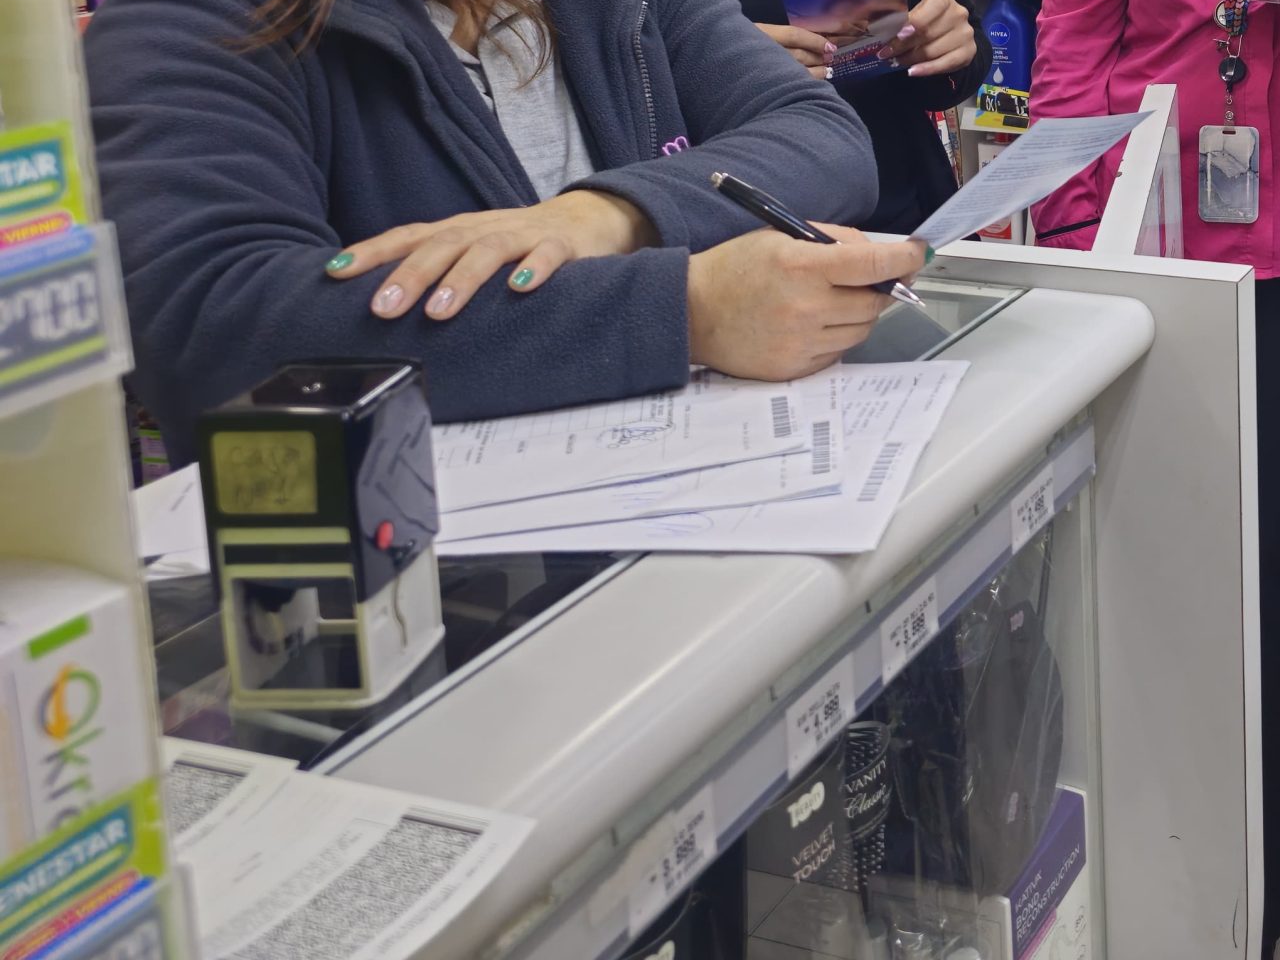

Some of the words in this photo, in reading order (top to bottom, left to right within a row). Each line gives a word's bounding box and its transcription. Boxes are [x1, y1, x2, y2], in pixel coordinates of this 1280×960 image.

[846, 755, 887, 793] VANITY
[792, 821, 834, 866] VELVET
[793, 838, 836, 884] TOUCH
[1017, 843, 1080, 942] RECONSTRUCTION
